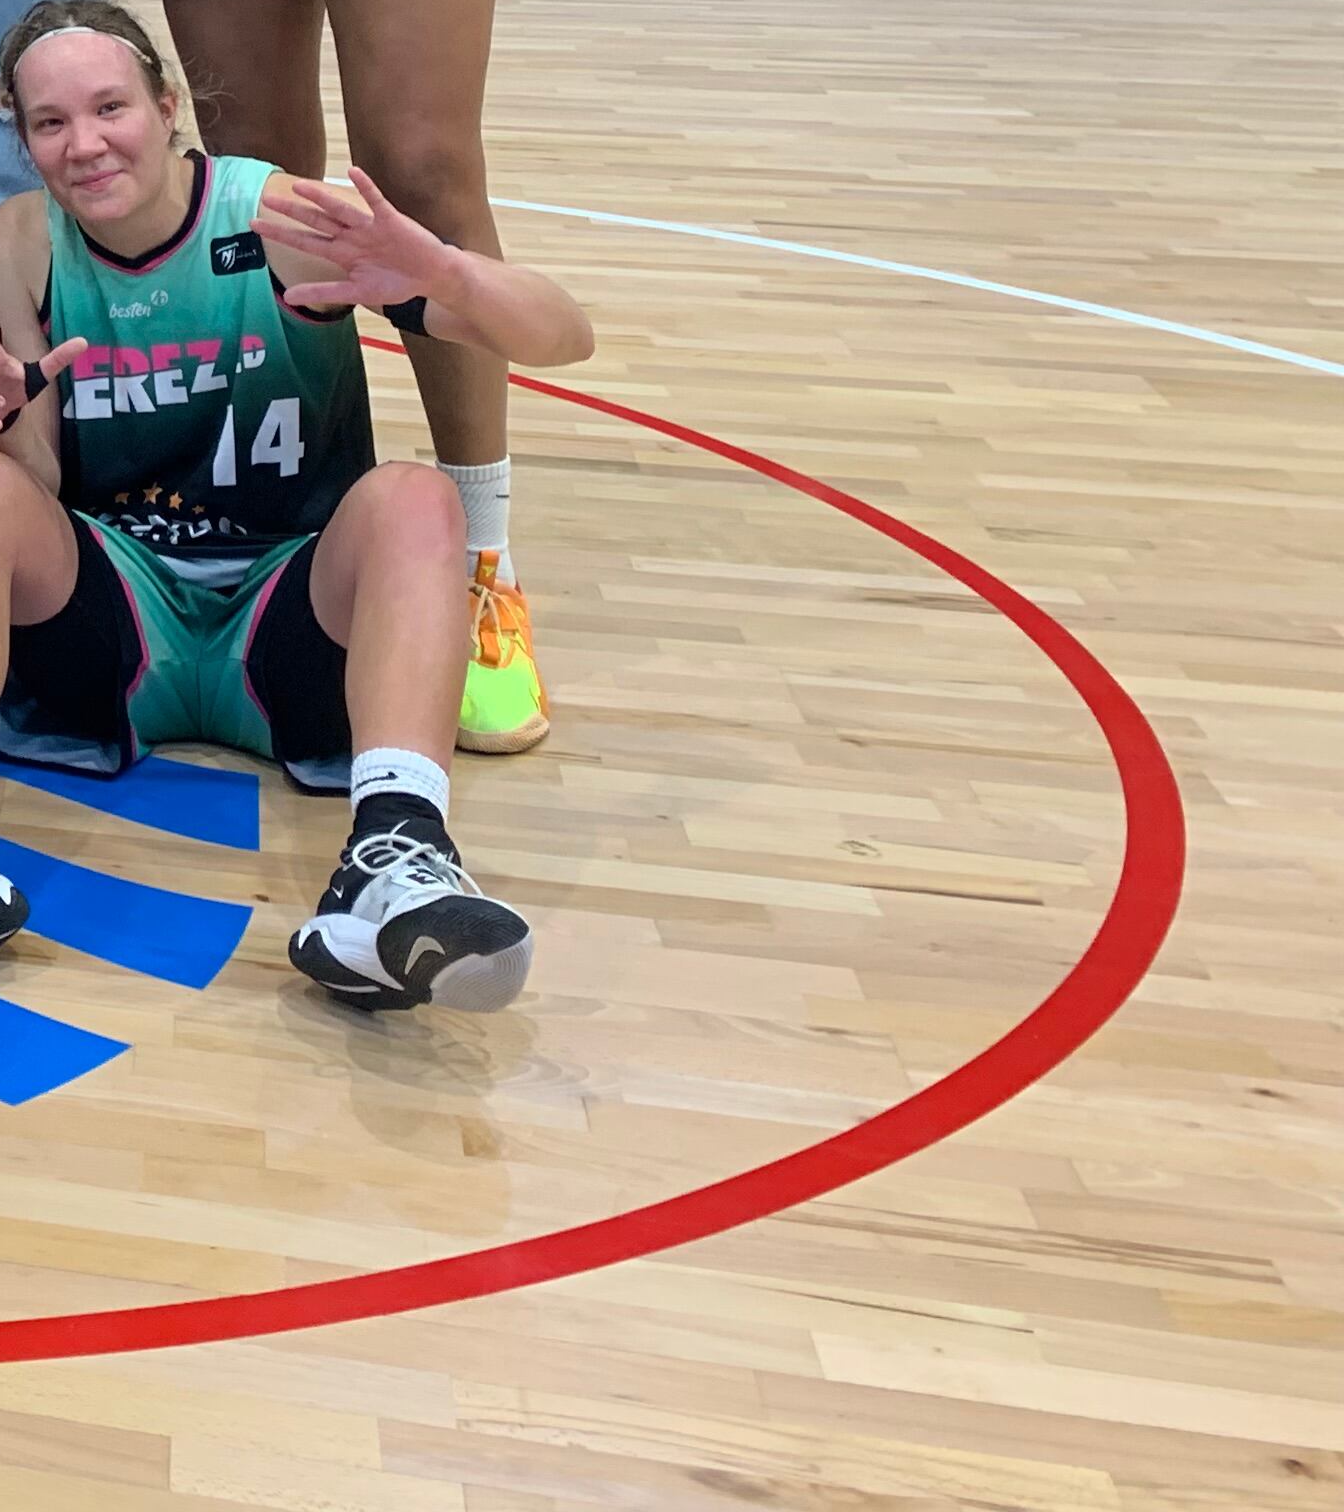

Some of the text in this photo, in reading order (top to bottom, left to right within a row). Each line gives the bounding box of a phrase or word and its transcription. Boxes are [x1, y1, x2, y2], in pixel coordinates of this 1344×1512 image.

[109, 300, 152, 320] besten
[63, 339, 229, 420] EREZ
[212, 396, 305, 487] 14
